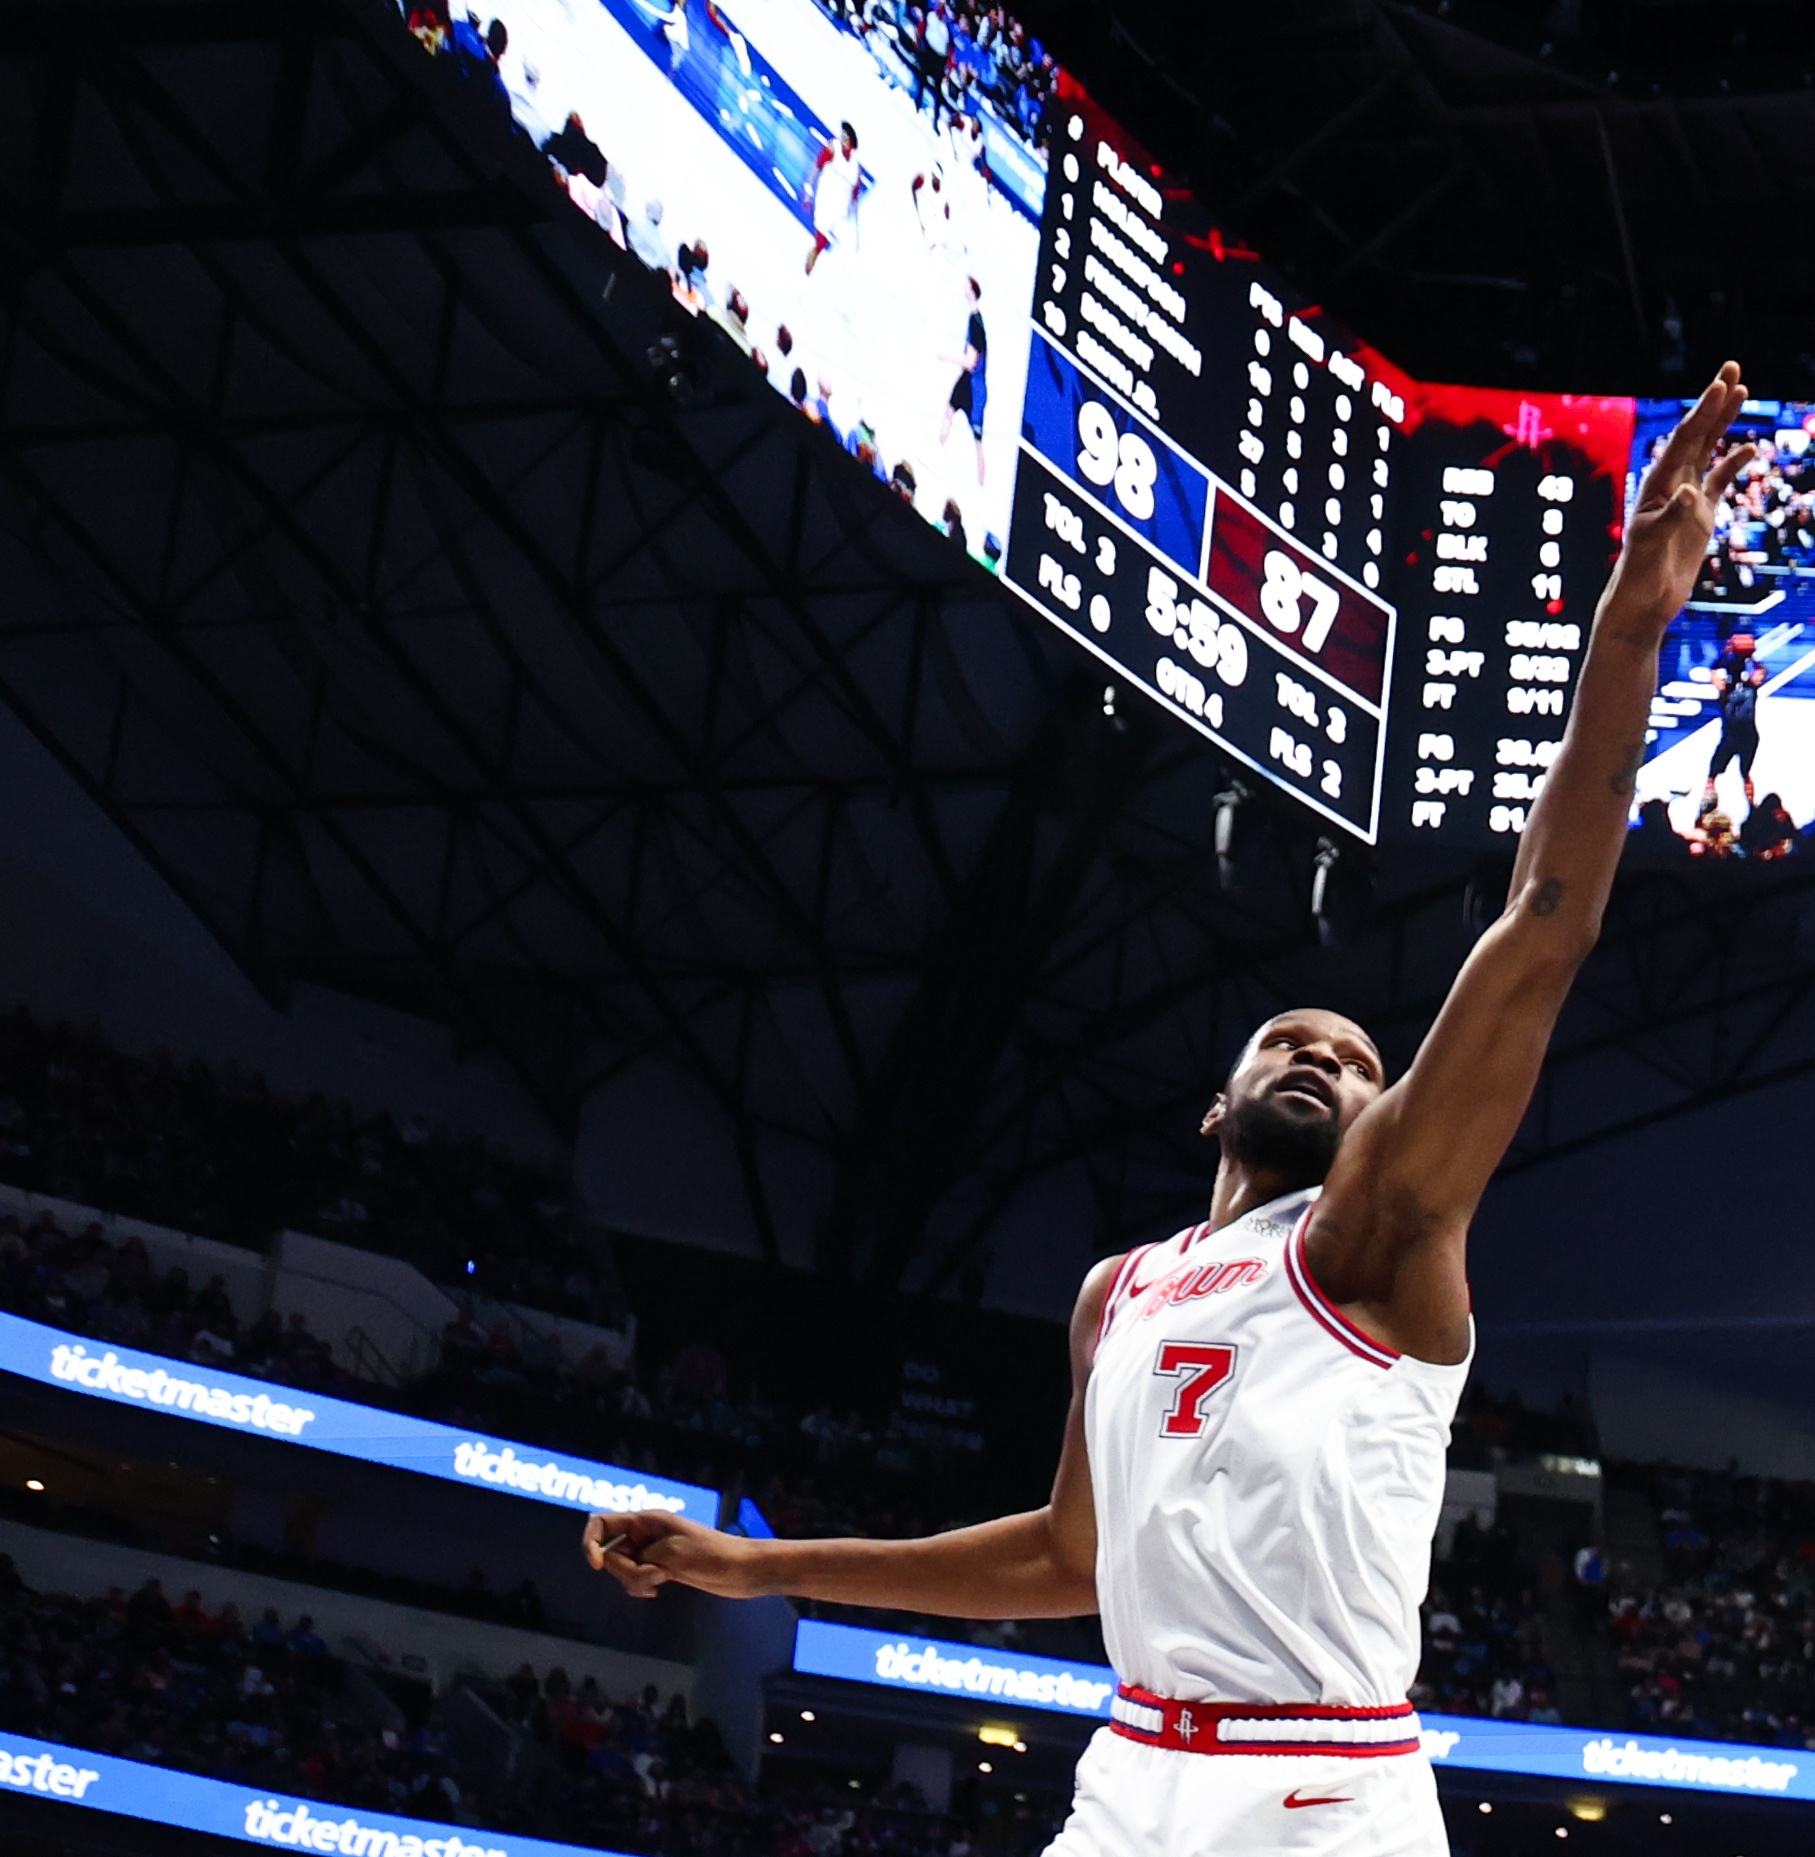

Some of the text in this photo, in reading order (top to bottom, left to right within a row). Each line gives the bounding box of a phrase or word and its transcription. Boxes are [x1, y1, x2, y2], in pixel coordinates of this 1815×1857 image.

[1076, 401, 1157, 520] 98
[1089, 594, 1110, 632] 0
[1260, 549, 1340, 654] 87
[1433, 565, 1562, 600] STL 11
[1145, 566, 1248, 687] 5:59
[1320, 759, 1342, 799] 2
[50, 1345, 315, 1435] ticketmaster
[1153, 1339, 1238, 1439] 7
[875, 1643, 1114, 1710] ticketmaster
[1582, 1739, 1798, 1791] ticketmaster
